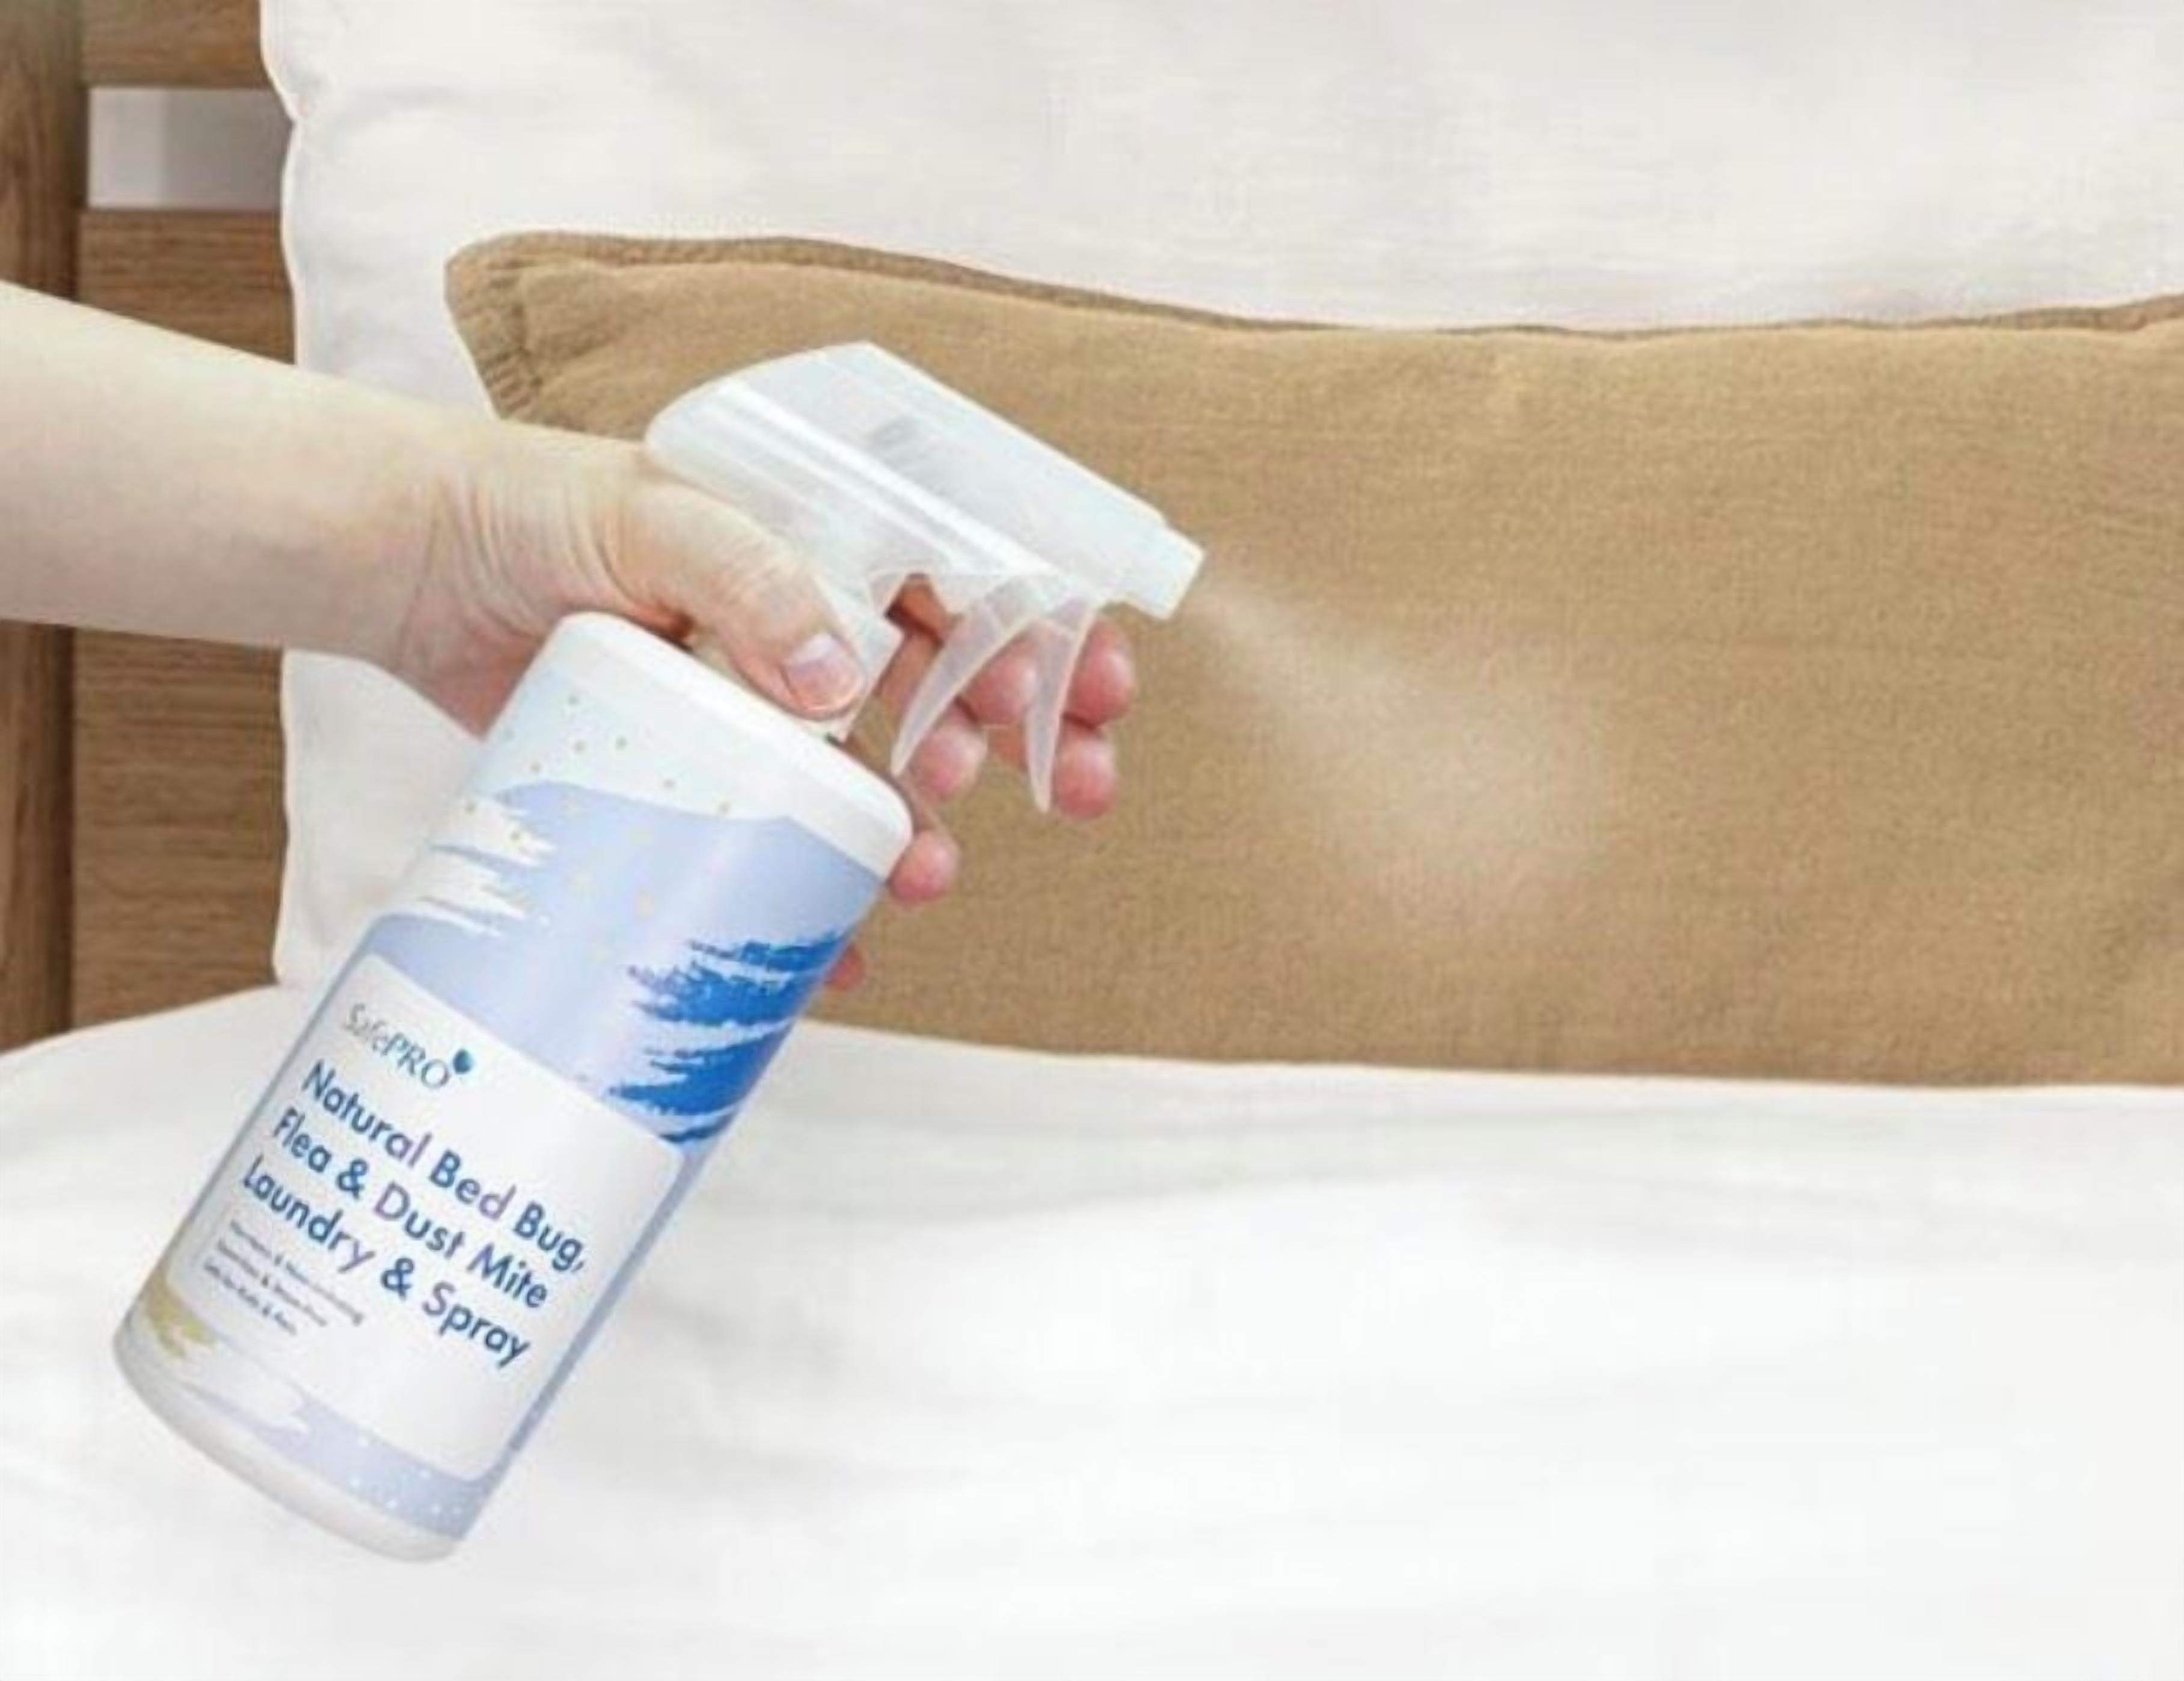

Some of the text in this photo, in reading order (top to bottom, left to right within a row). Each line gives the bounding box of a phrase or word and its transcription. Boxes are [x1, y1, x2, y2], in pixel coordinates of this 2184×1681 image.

[242, 1156, 375, 1274] Laundry
[379, 1256, 416, 1300] &
[422, 1282, 532, 1369] Spray
[273, 1107, 548, 1309] Flea & Dust Mite
[301, 1059, 586, 1273] Natural Bed Bug,
